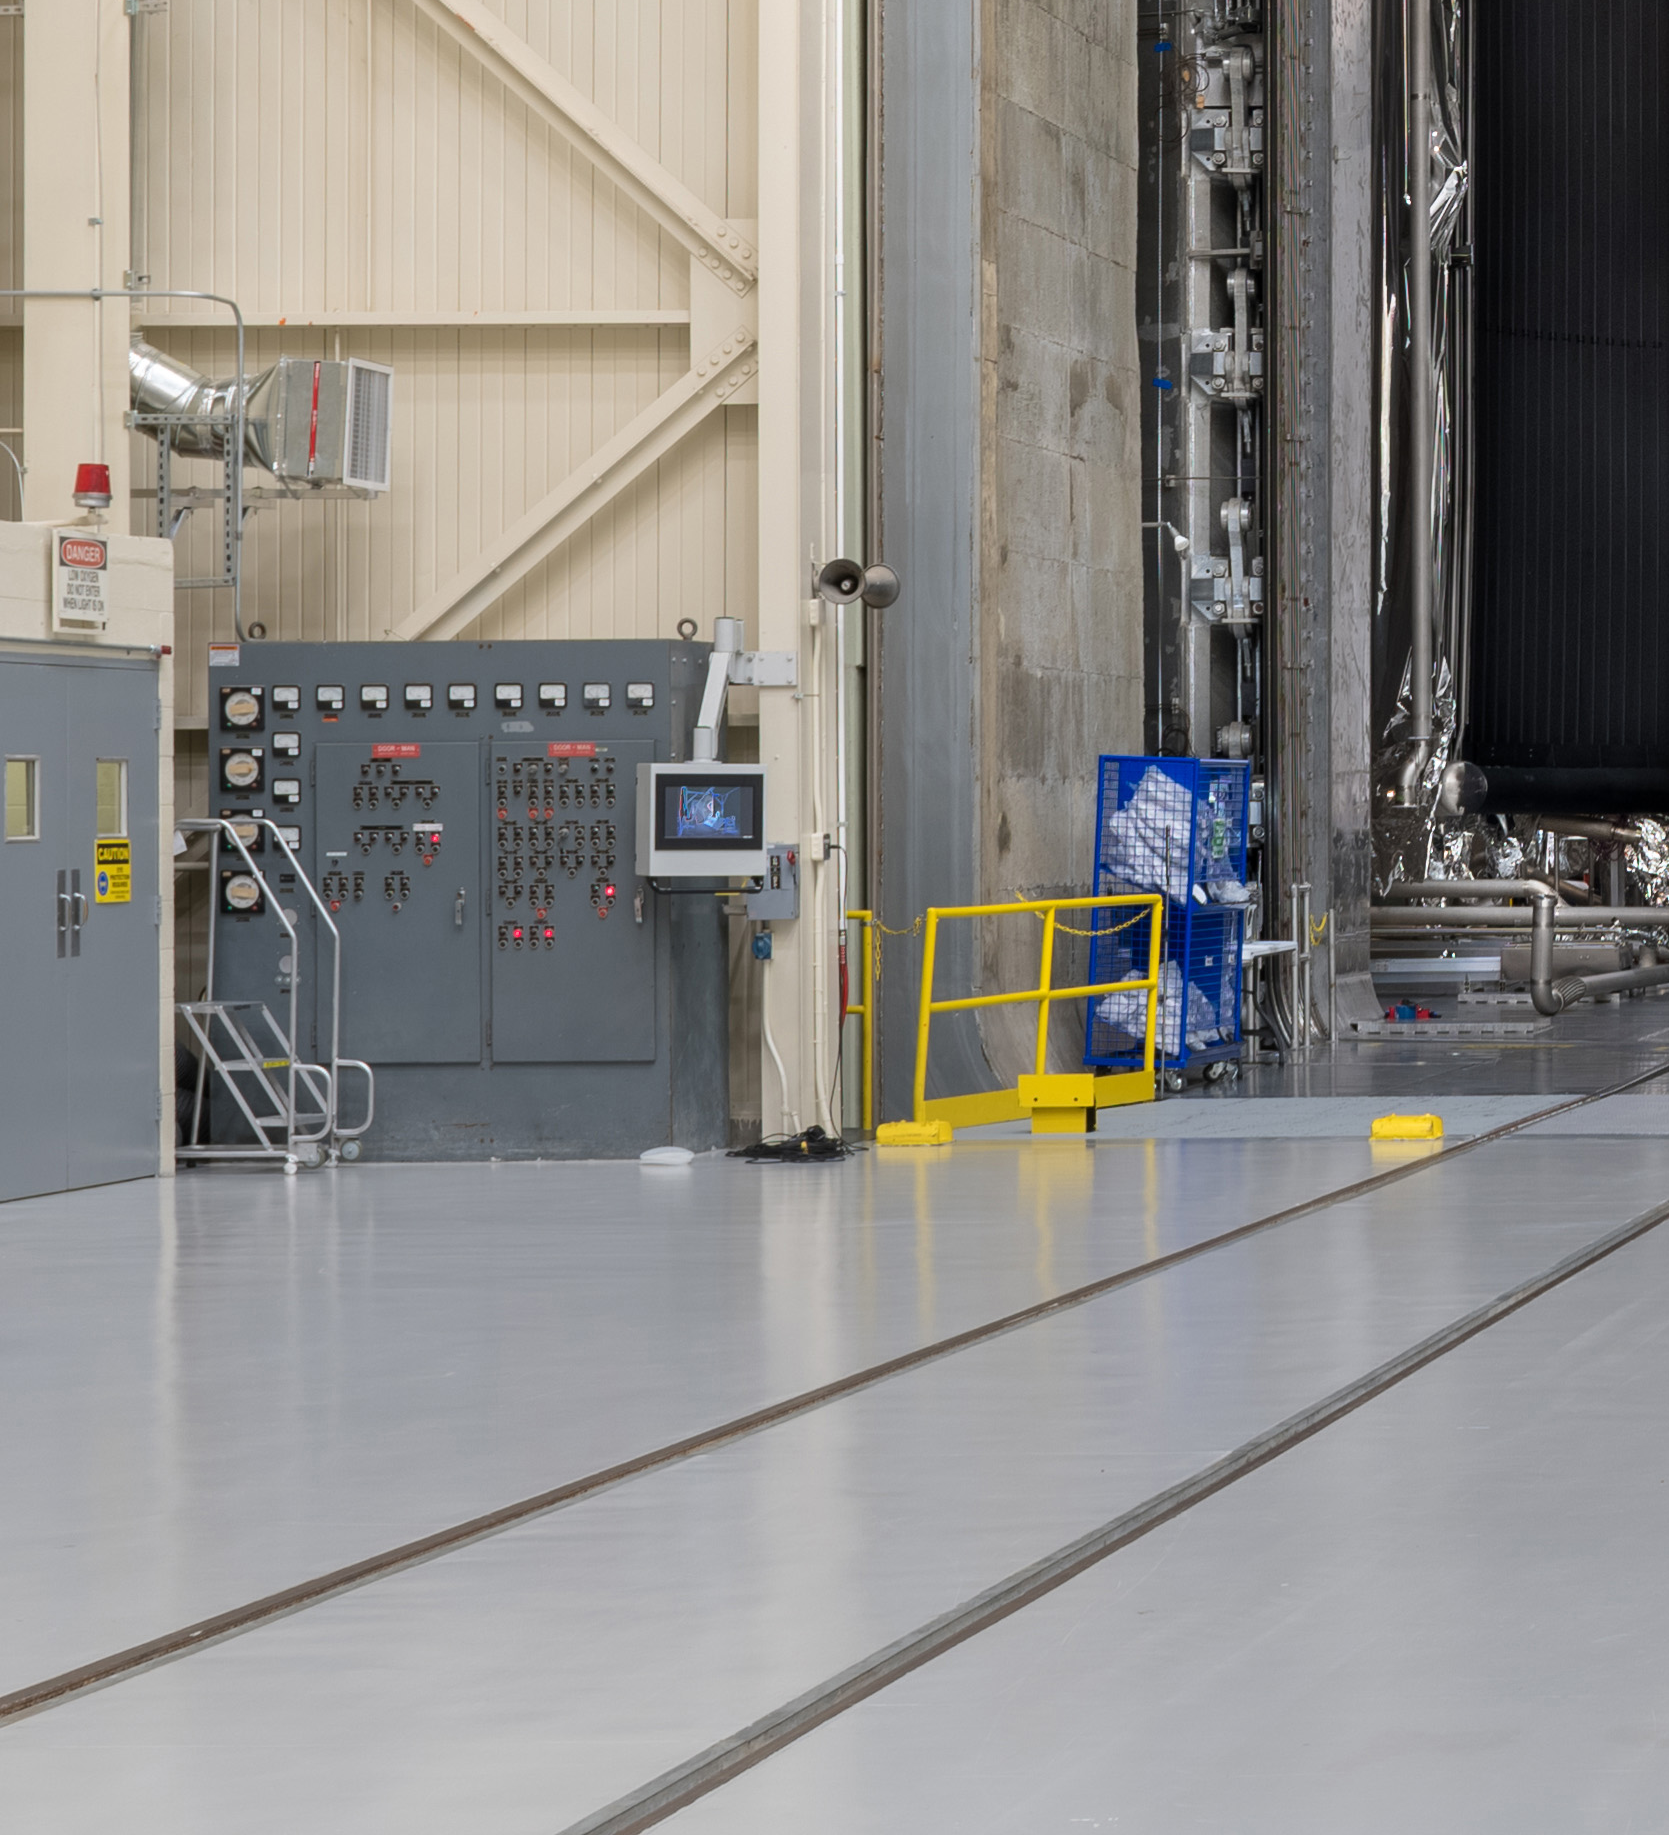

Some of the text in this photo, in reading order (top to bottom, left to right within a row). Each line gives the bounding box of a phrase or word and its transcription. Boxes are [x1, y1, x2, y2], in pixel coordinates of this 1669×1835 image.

[65, 544, 101, 563] DANGER
[80, 570, 99, 583] OXYGEN
[67, 583, 100, 597] DO NOT ENTER
[63, 597, 77, 609] WHEN
[78, 598, 92, 610] LIGHT
[98, 847, 129, 860] CAUTION
